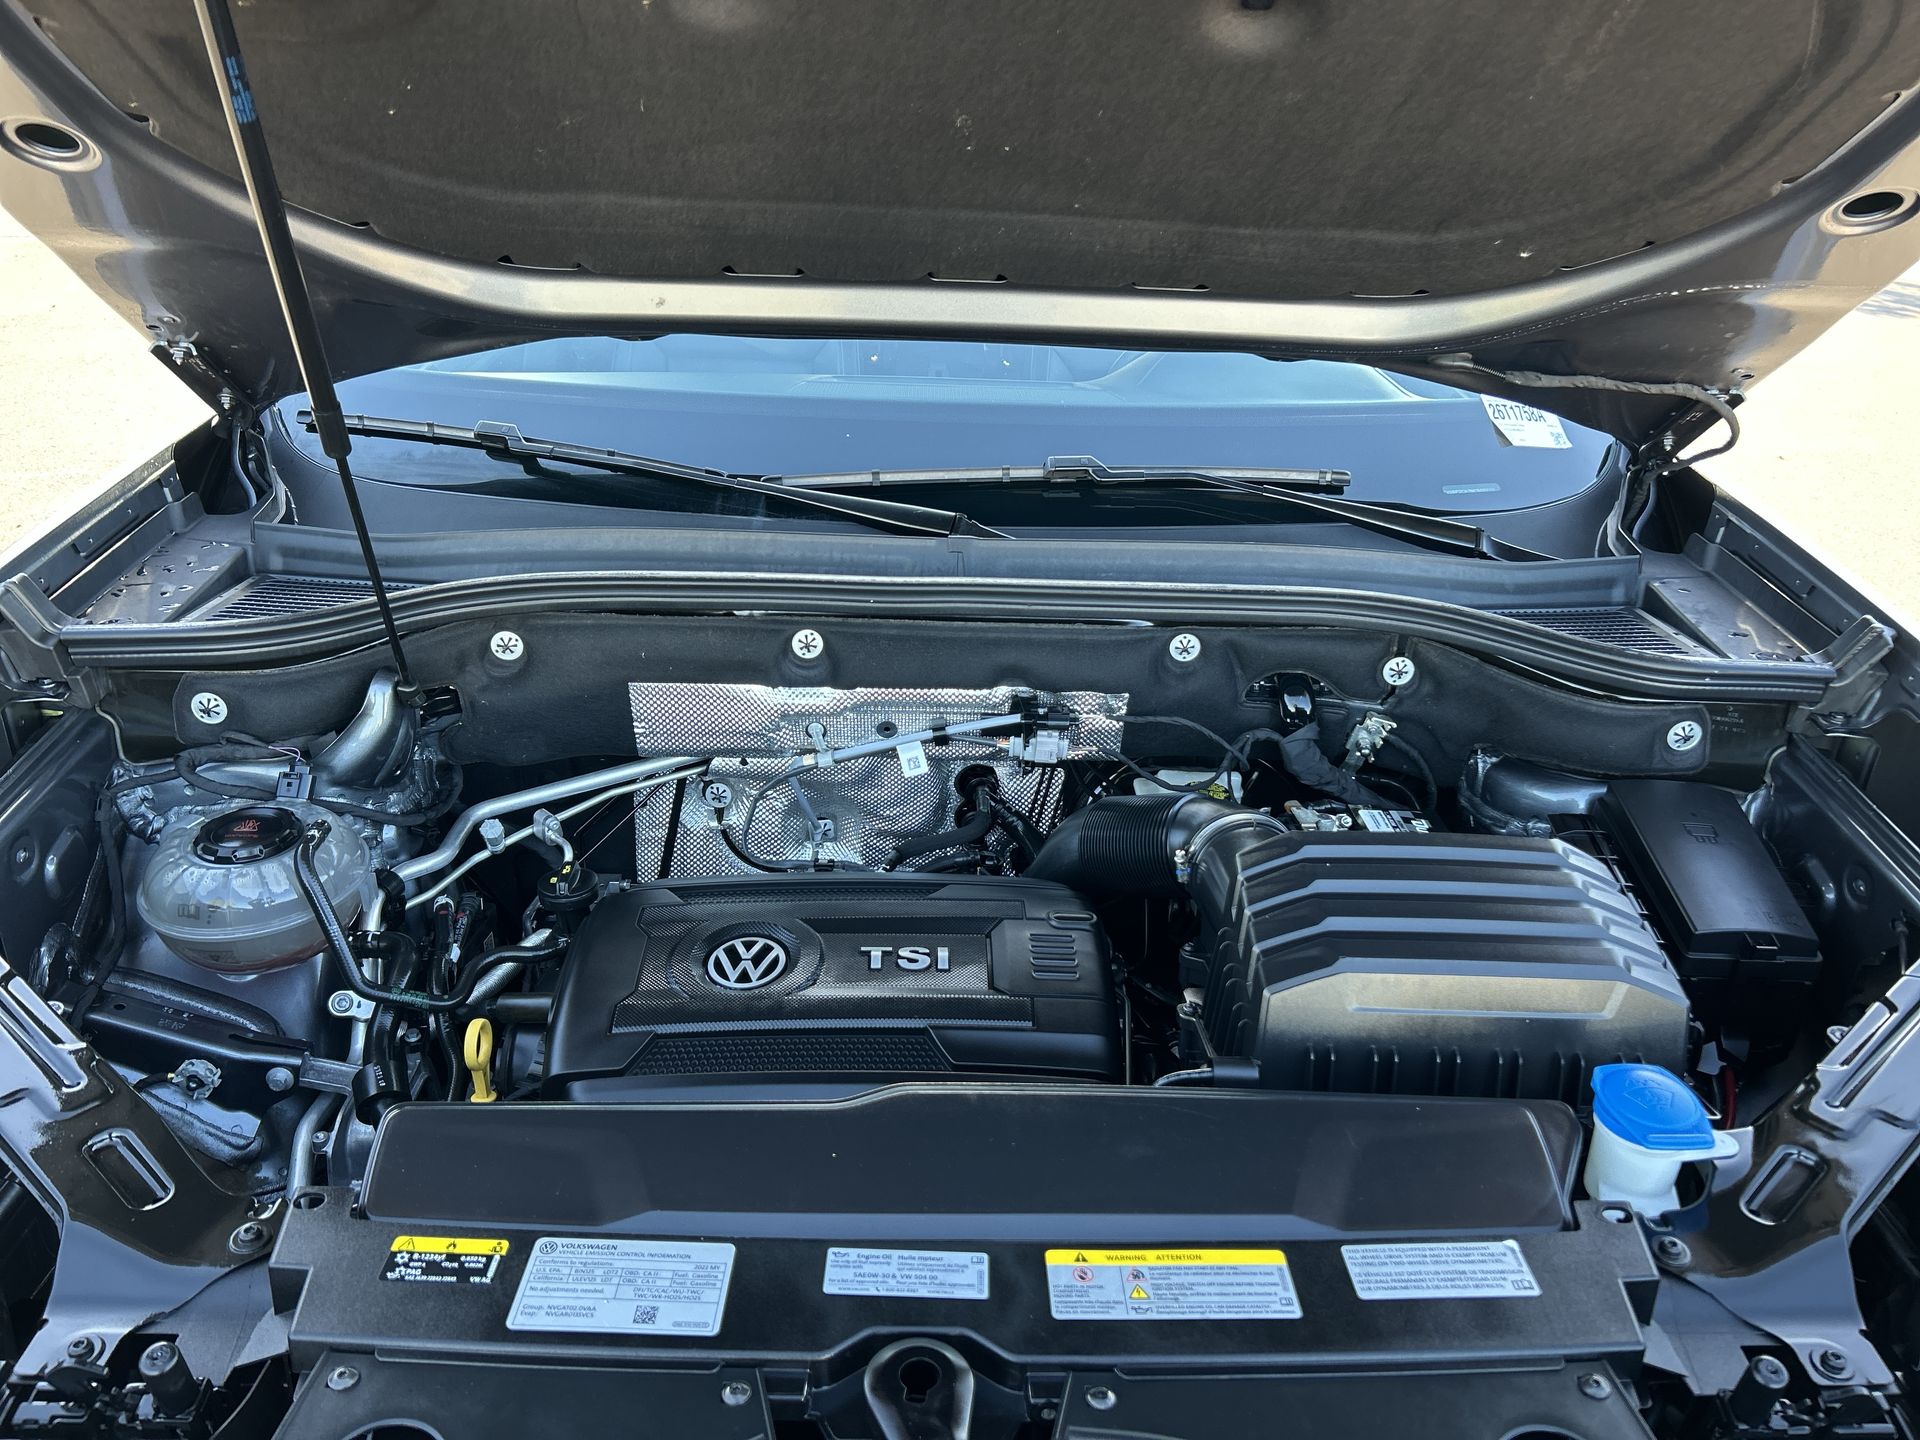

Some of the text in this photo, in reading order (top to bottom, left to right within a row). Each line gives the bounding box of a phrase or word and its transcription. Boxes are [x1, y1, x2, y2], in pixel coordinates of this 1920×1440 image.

[1488, 403, 1547, 423] 26T1758A
[860, 946, 950, 971] TSI
[561, 1243, 618, 1251] VOLKSWAGEN
[647, 1252, 691, 1260] INFORMATION
